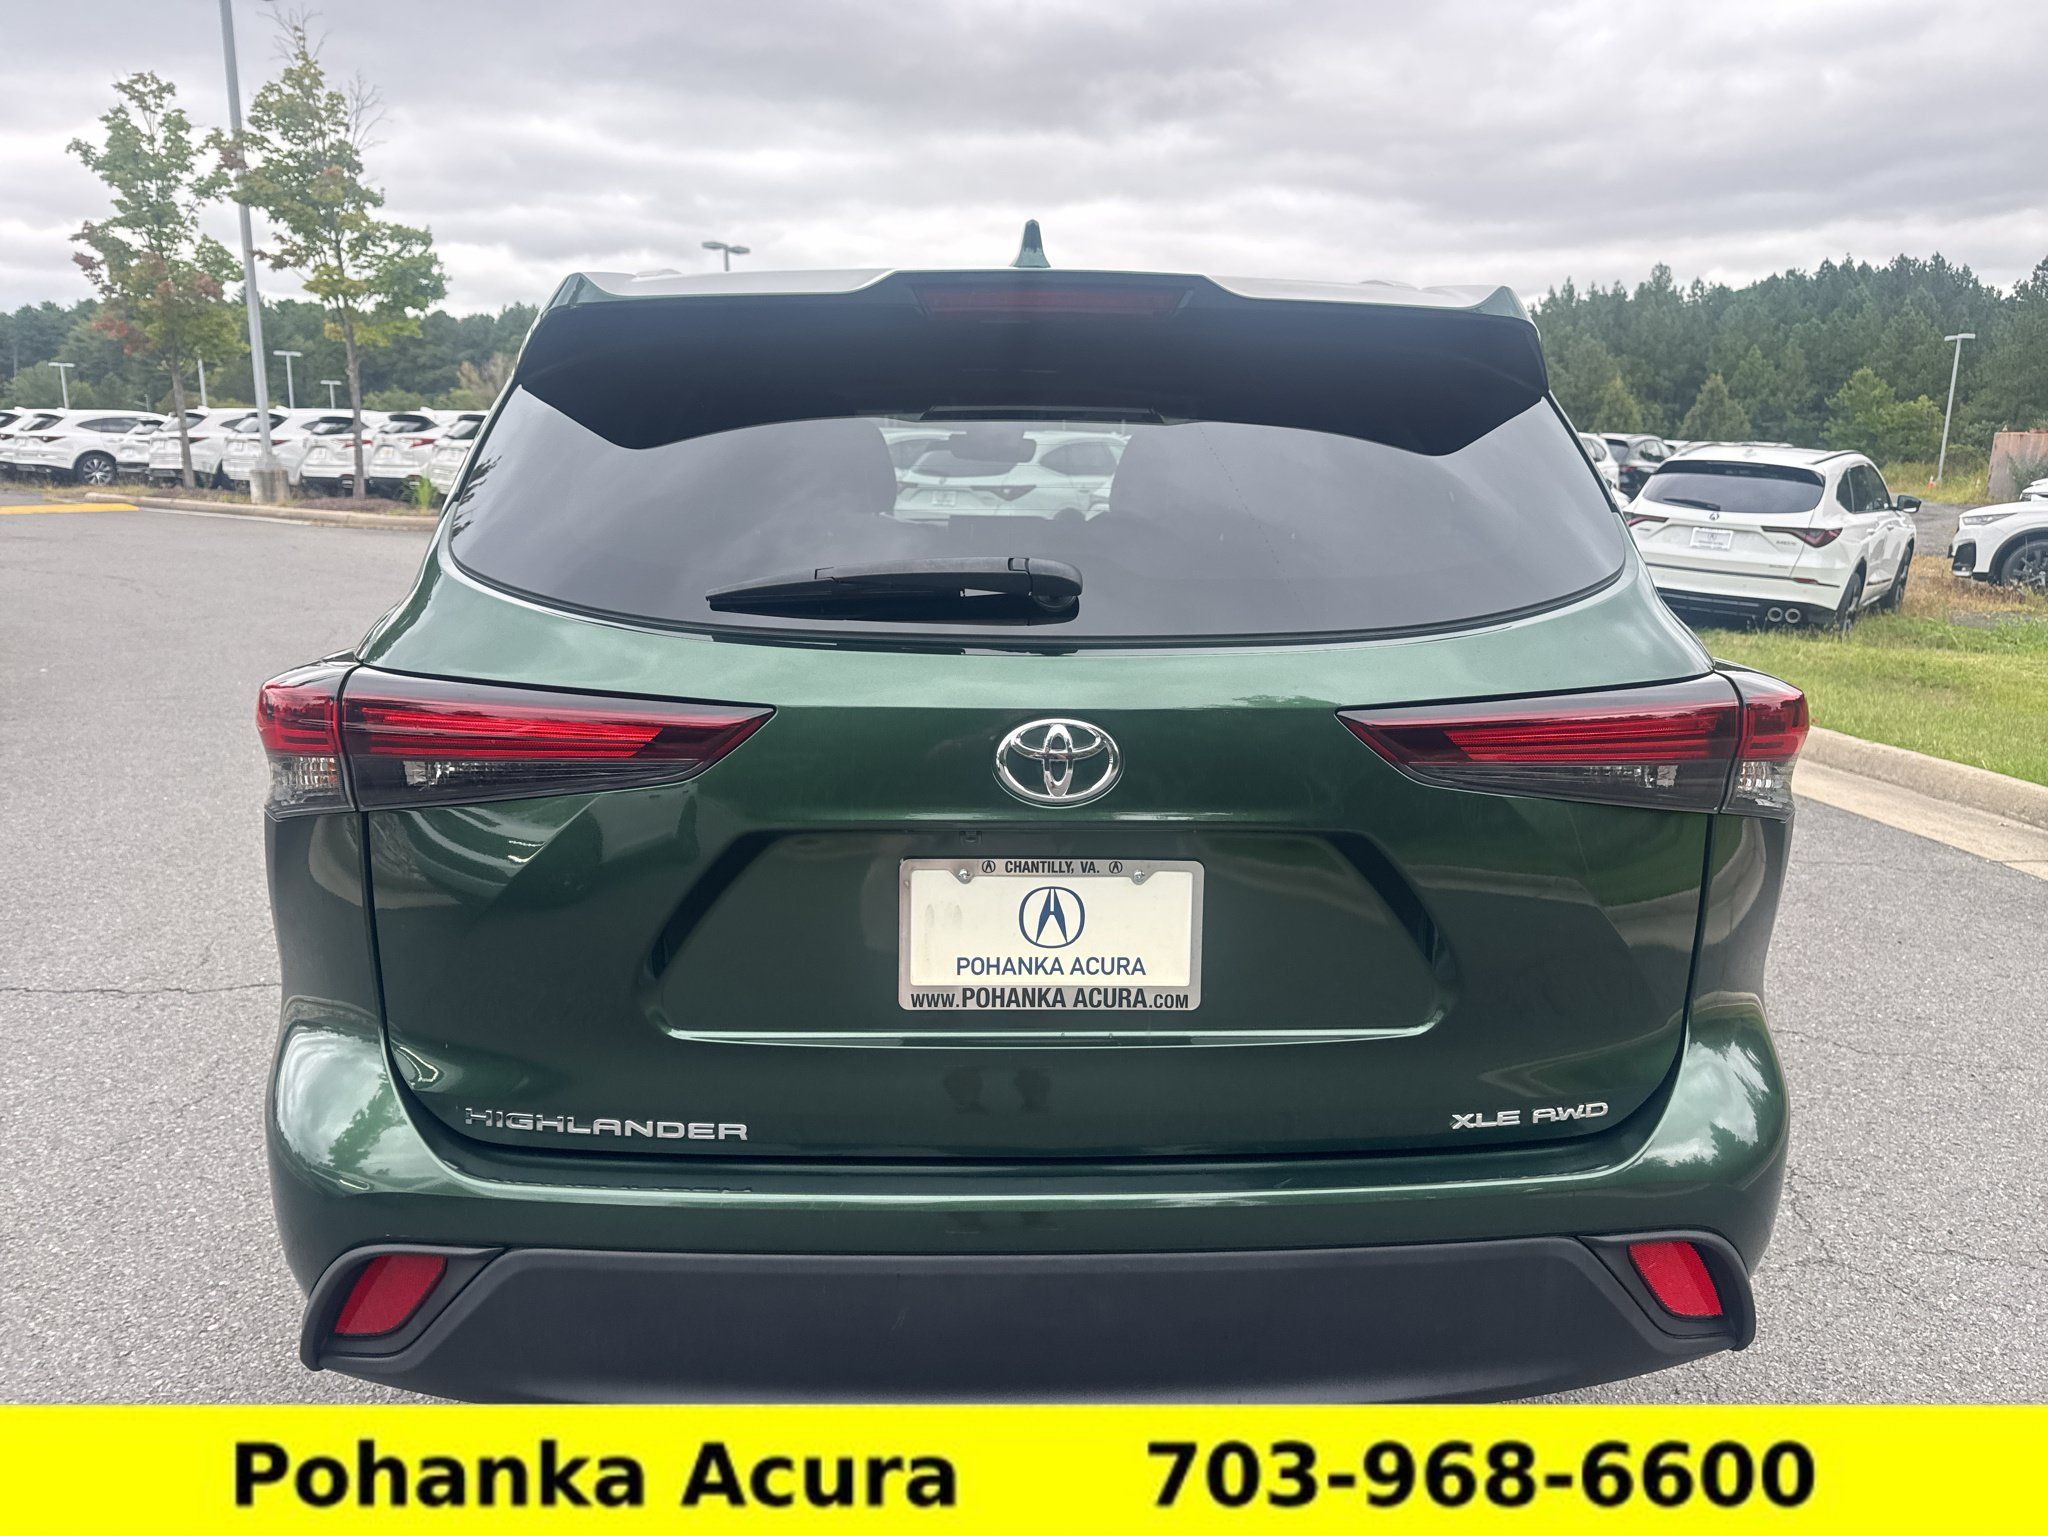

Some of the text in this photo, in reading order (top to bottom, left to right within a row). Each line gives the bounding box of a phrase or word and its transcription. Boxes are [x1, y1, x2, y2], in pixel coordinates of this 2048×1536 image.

[1004, 860, 1100, 874] CHANTILLY, VA.
[956, 956, 1147, 976] POHANKA ACURA
[465, 1107, 748, 1141] HIGHLANDER
[1450, 1101, 1609, 1130] XLE AWD
